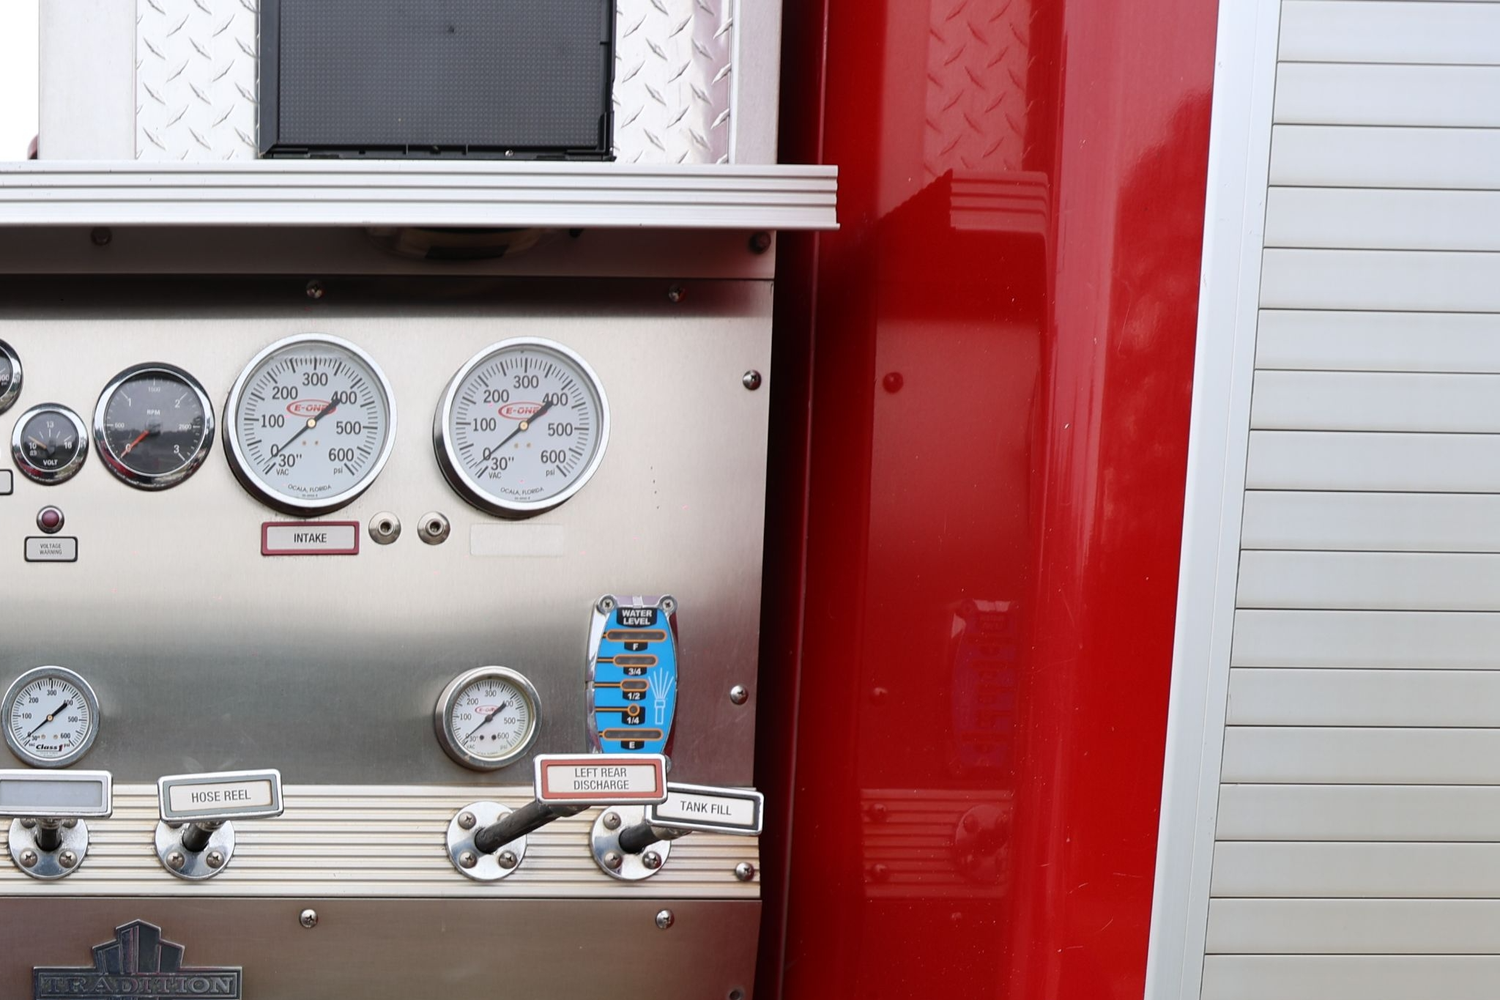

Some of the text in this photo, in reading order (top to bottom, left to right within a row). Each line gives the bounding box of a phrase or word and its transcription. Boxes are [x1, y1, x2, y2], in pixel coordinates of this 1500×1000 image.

[302, 372, 328, 386] 300
[513, 375, 539, 389] 300
[272, 386, 298, 400] 200
[331, 391, 358, 404] 400
[483, 390, 509, 403] 200
[542, 393, 568, 407] 400
[260, 415, 285, 428] 100
[335, 421, 362, 435] 500
[472, 417, 497, 432] 100
[547, 423, 573, 436] 500
[329, 449, 354, 462] 600
[541, 450, 566, 463] 600
[276, 468, 289, 476] VAC
[333, 466, 343, 476] psi
[489, 471, 502, 480] VAC
[293, 533, 327, 543] INTAKE
[622, 610, 652, 618] WATER
[623, 617, 651, 625] LEVEL
[627, 692, 640, 700] 1/2
[574, 767, 627, 777] LEFT REAR
[573, 780, 630, 791] DISCHARGE
[191, 789, 252, 803] HOSE REEL
[680, 801, 732, 816] TANK FILL
[41, 974, 236, 995] TRADITION
